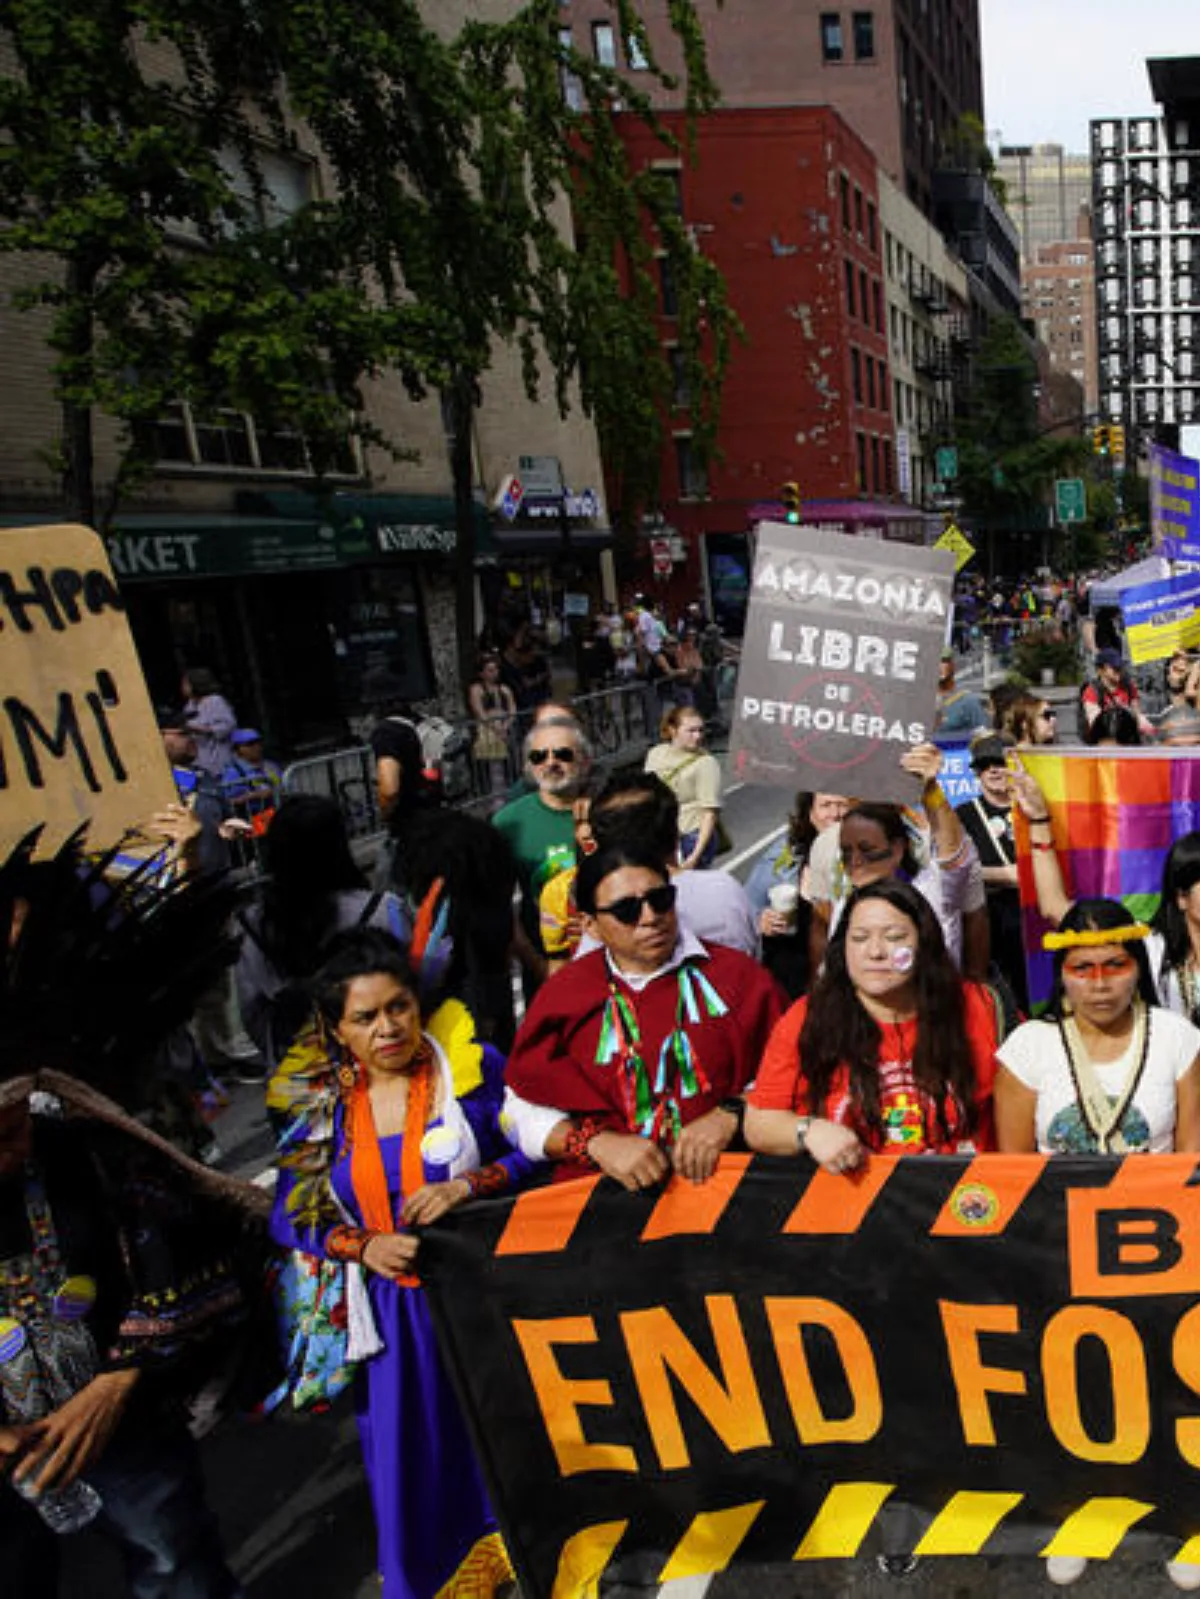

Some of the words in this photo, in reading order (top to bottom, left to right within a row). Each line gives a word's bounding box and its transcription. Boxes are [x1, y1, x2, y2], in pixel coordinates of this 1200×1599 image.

[106, 534, 200, 575] RKET
[0, 566, 126, 632] HPA
[767, 620, 920, 682] LIBRE
[741, 696, 926, 744] PETROLERAS
[511, 1295, 884, 1476] END
